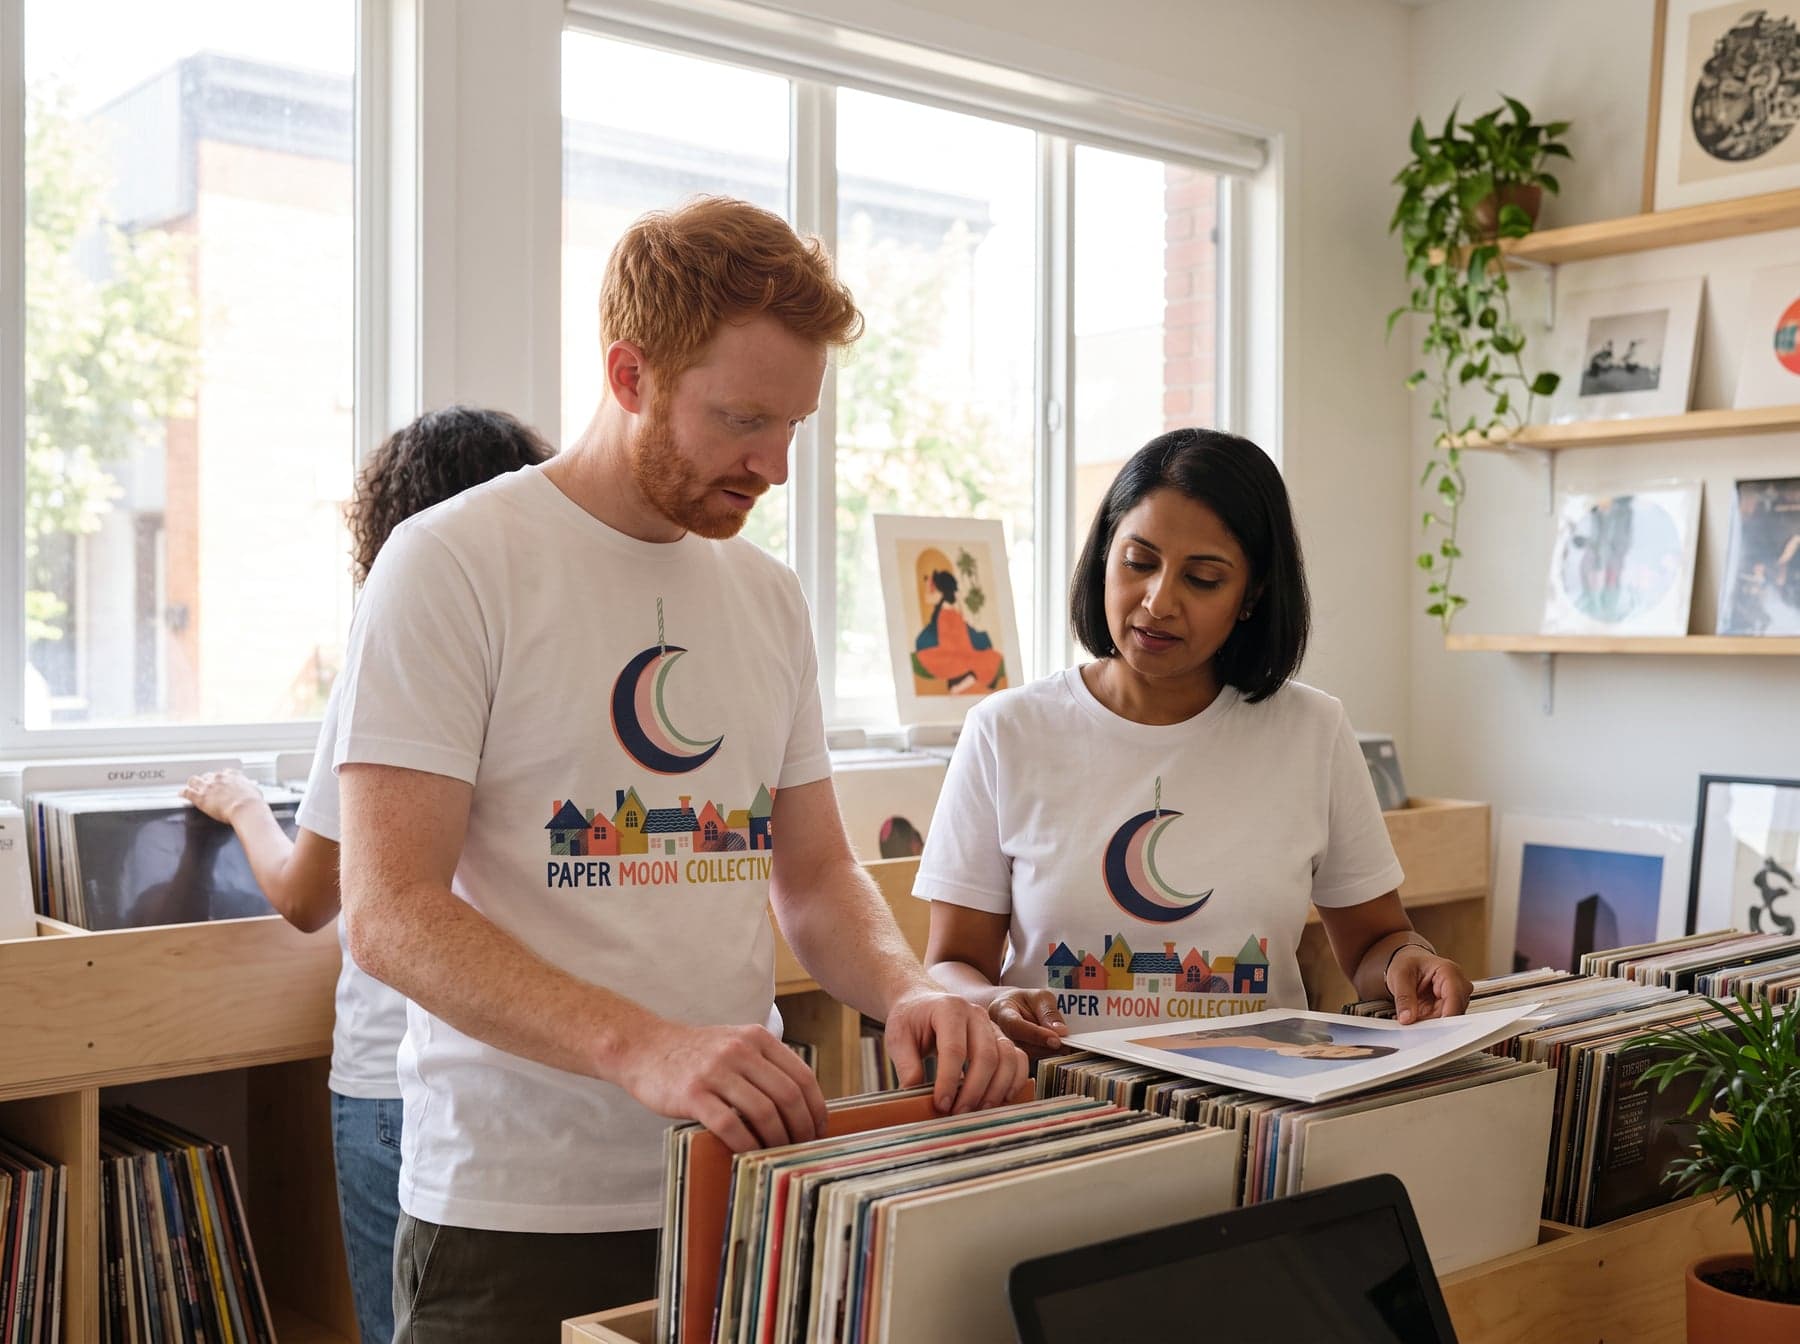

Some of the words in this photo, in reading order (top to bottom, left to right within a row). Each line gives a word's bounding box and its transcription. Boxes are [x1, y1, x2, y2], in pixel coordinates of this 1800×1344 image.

[547, 861, 612, 888] PAPER
[618, 860, 678, 886] MOON
[685, 856, 772, 884] COLLECTIV
[1056, 993, 1100, 1017] APER
[1106, 995, 1160, 1018] MOON
